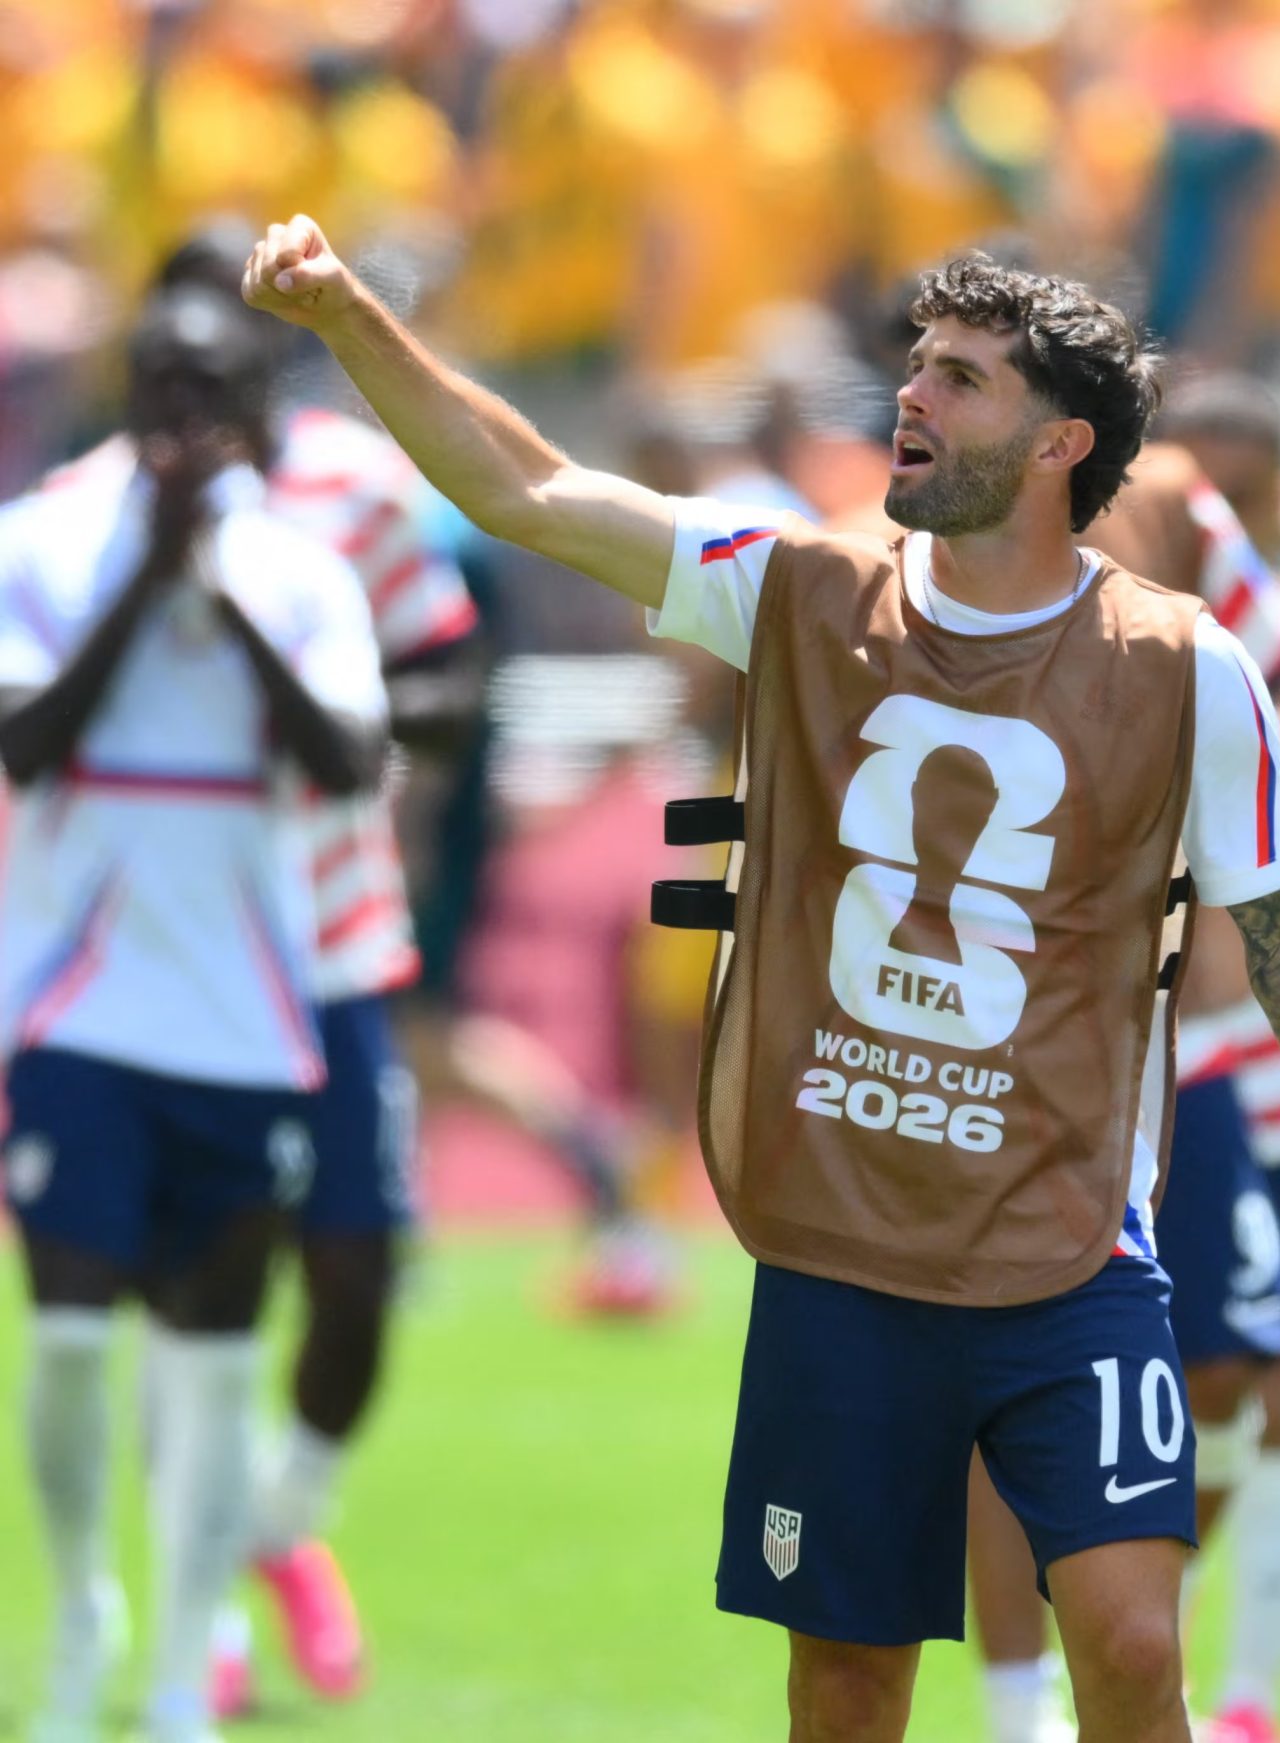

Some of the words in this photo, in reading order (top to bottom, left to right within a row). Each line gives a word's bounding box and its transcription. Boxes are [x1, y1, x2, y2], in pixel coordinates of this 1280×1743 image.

[876, 964, 966, 1017] FIFA
[815, 1029, 933, 1083] WORLD
[938, 1062, 1015, 1099] CUP
[796, 1068, 1006, 1153] 2026
[1091, 1357, 1185, 1467] 10
[767, 1508, 799, 1539] USA
